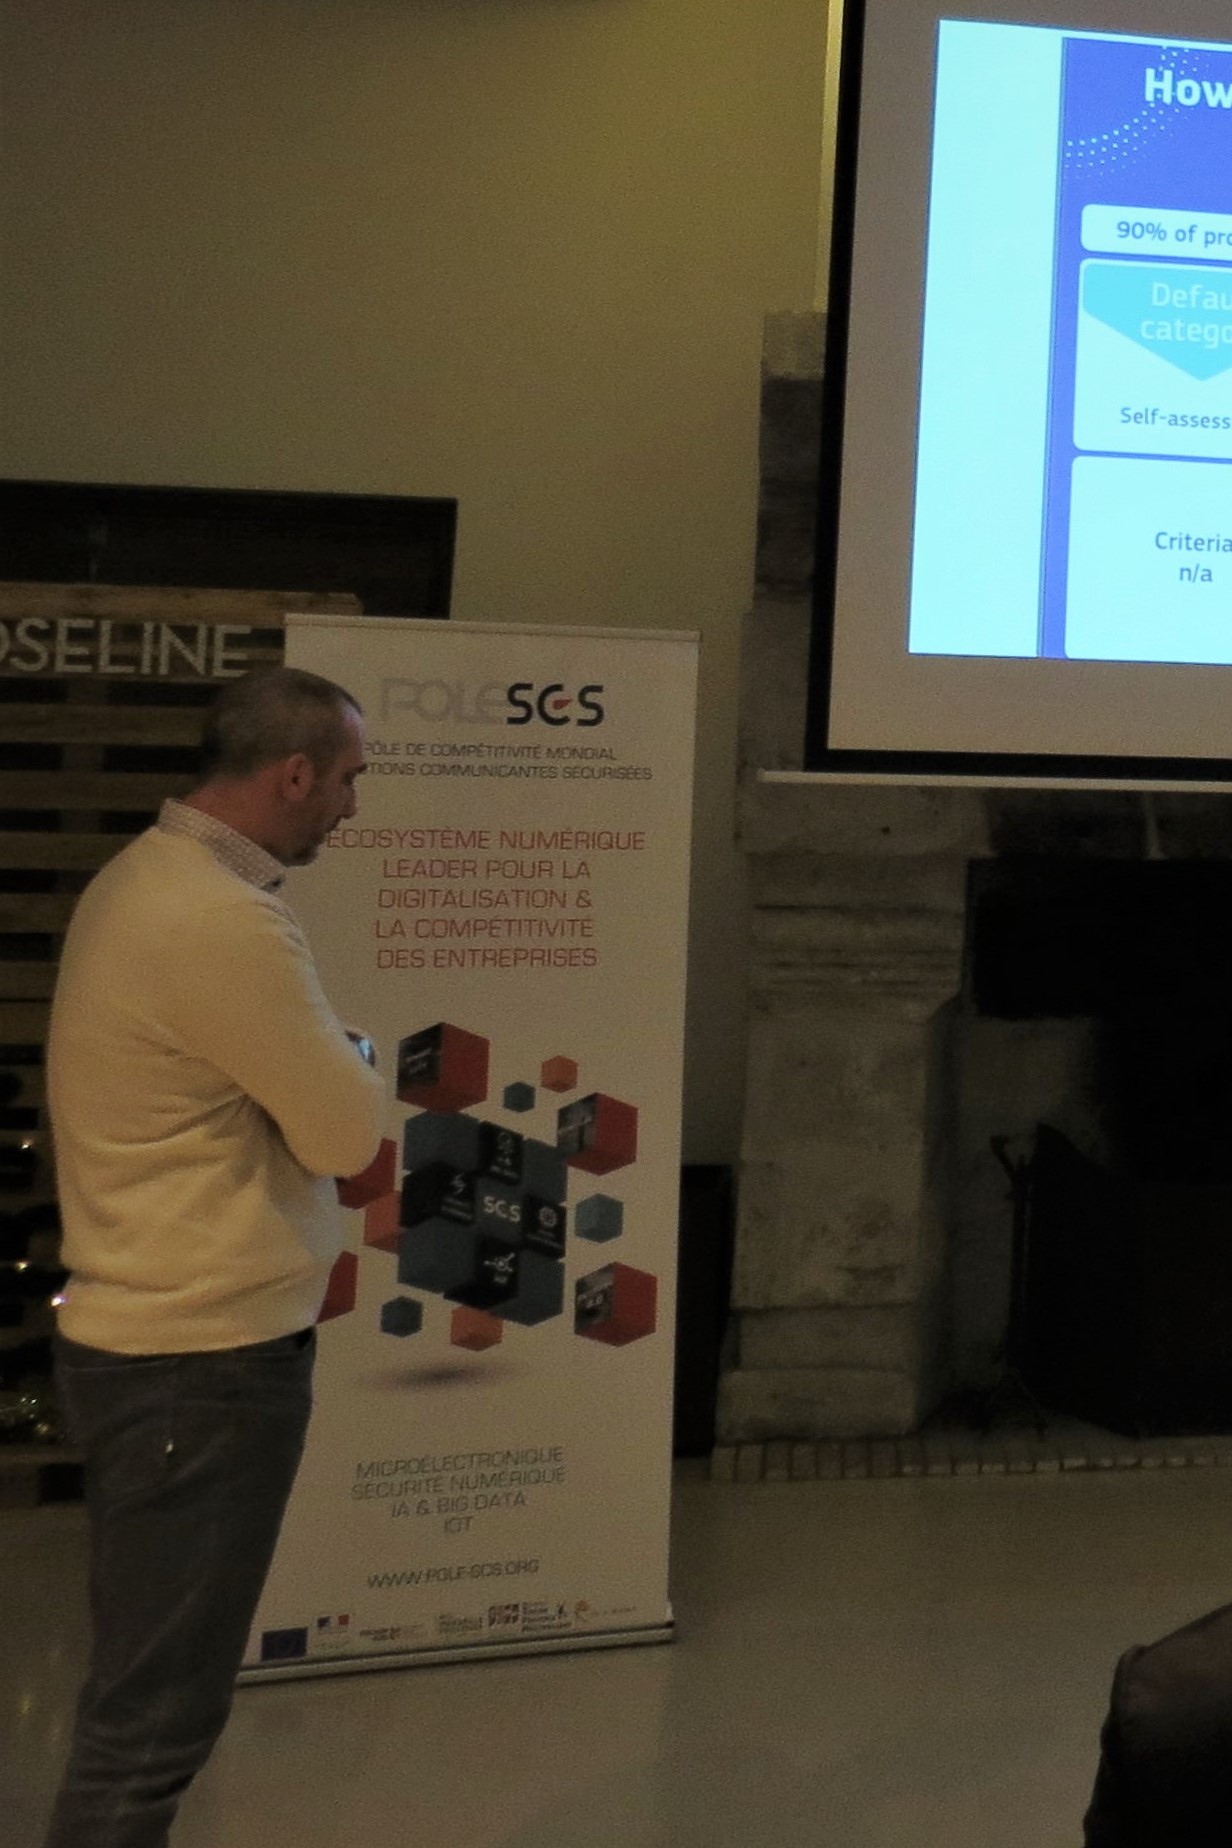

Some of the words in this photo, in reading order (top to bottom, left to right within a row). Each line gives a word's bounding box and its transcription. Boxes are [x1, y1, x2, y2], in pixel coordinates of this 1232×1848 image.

[1117, 221, 1166, 240] 90%
[1175, 225, 1197, 242] of
[1180, 564, 1212, 582] n/a
[0, 618, 252, 678] SELINE
[405, 743, 426, 756] DE
[431, 742, 542, 759] COMPÉTITIVITÉ
[547, 746, 617, 761] MONDIAL
[420, 763, 558, 779] COMMUNICANTES
[499, 827, 646, 851] NUMÉRIQUE
[383, 858, 478, 879] LEADER
[486, 859, 553, 879] POUR
[562, 859, 591, 879] LA
[378, 889, 567, 908] DIGITALISATION
[576, 889, 592, 908] &
[375, 920, 406, 939] LA
[377, 948, 425, 969] DES
[433, 947, 598, 968] ENTREPRISES
[483, 1196, 521, 1223] SCS
[416, 1500, 430, 1515] &
[437, 1497, 469, 1514] BIG
[475, 1491, 527, 1510] DATA
